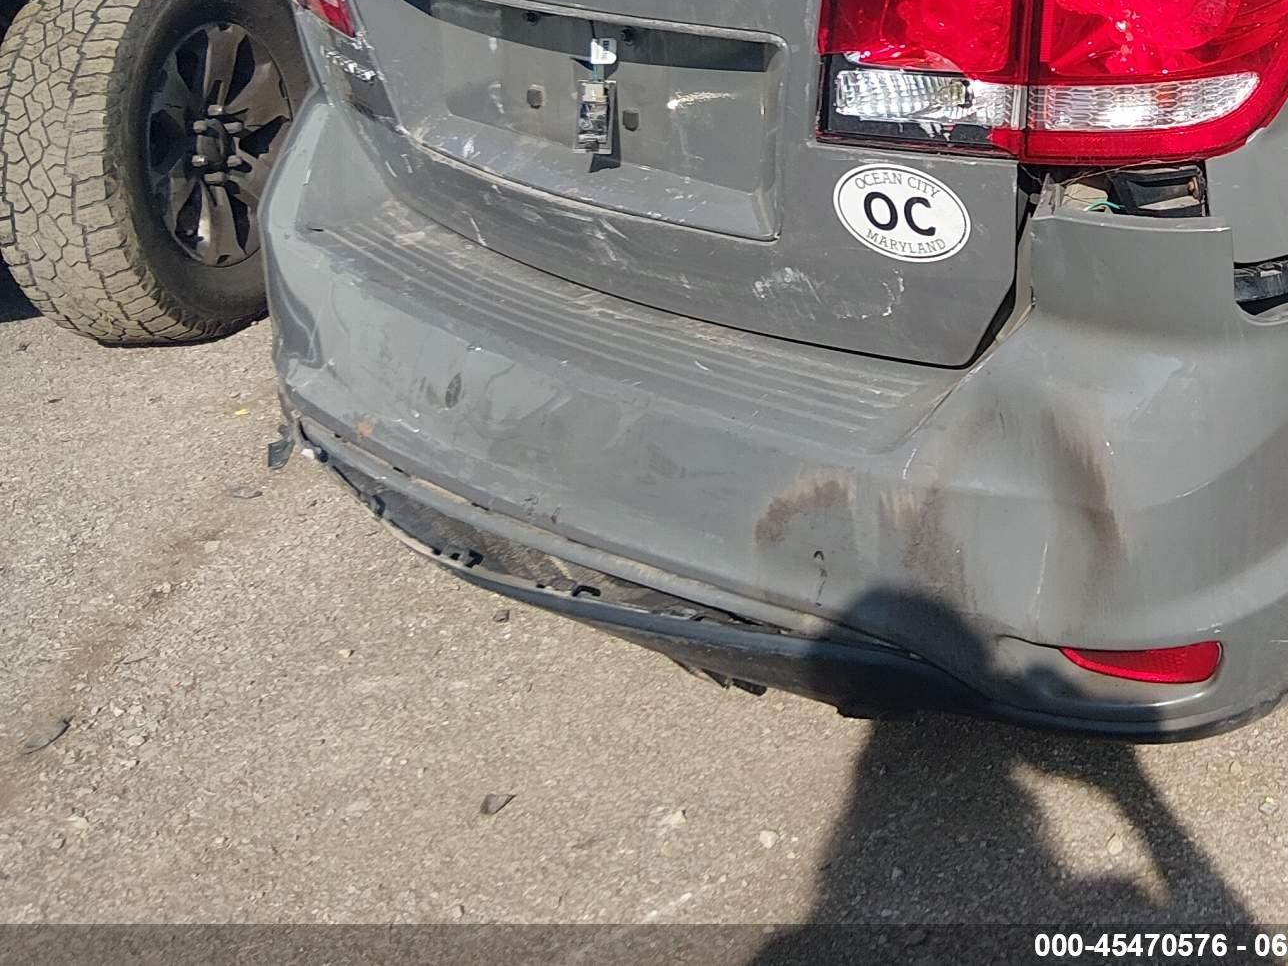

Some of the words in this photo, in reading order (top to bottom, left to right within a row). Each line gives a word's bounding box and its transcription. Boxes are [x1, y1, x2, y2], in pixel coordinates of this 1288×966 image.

[854, 171, 902, 190] OCEAN
[907, 176, 941, 198] CITY
[863, 191, 937, 237] OC
[865, 229, 946, 255] MARYLAND
